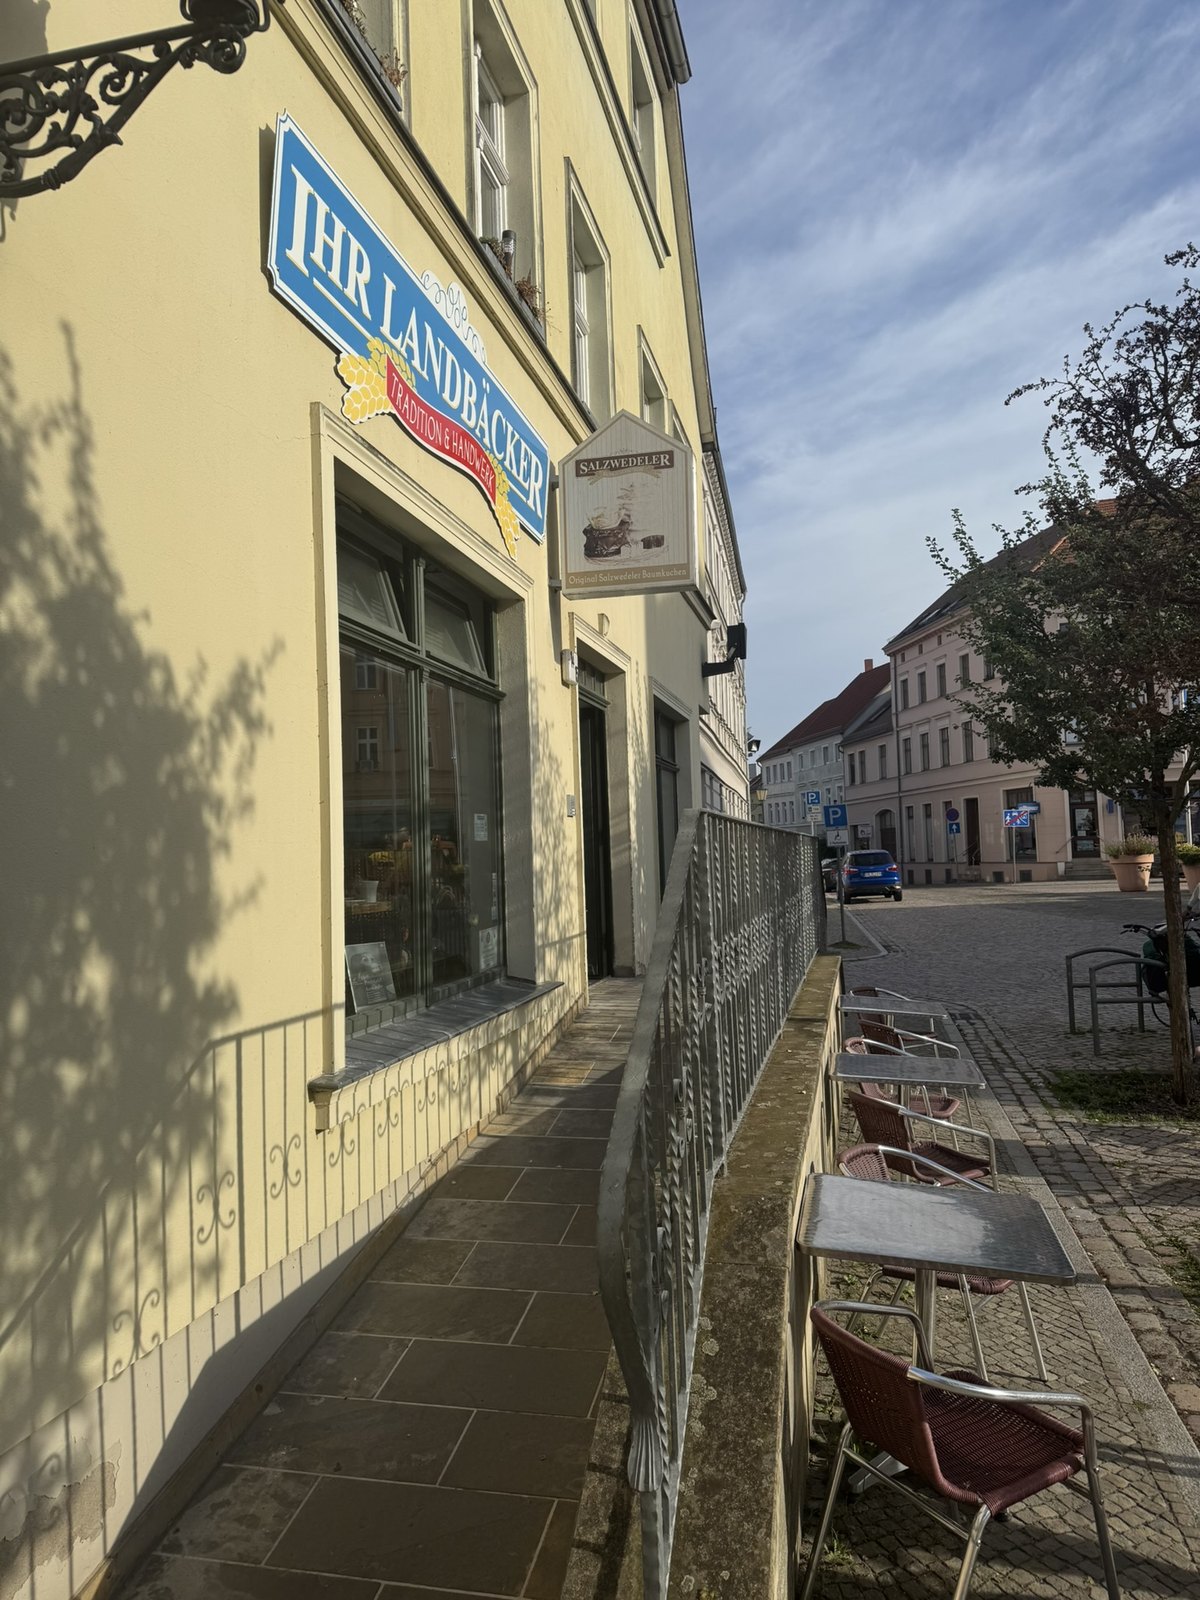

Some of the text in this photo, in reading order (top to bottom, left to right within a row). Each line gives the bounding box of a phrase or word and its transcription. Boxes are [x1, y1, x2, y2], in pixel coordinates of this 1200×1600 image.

[286, 164, 544, 519] IHR LANDBÄCKER
[391, 373, 495, 493] TRADITION & HANDWERK
[579, 453, 671, 475] SALZWEDELER
[568, 567, 687, 585] Original Salzwedeler Baumkuchen
[808, 792, 817, 804] P
[828, 807, 842, 825] P
